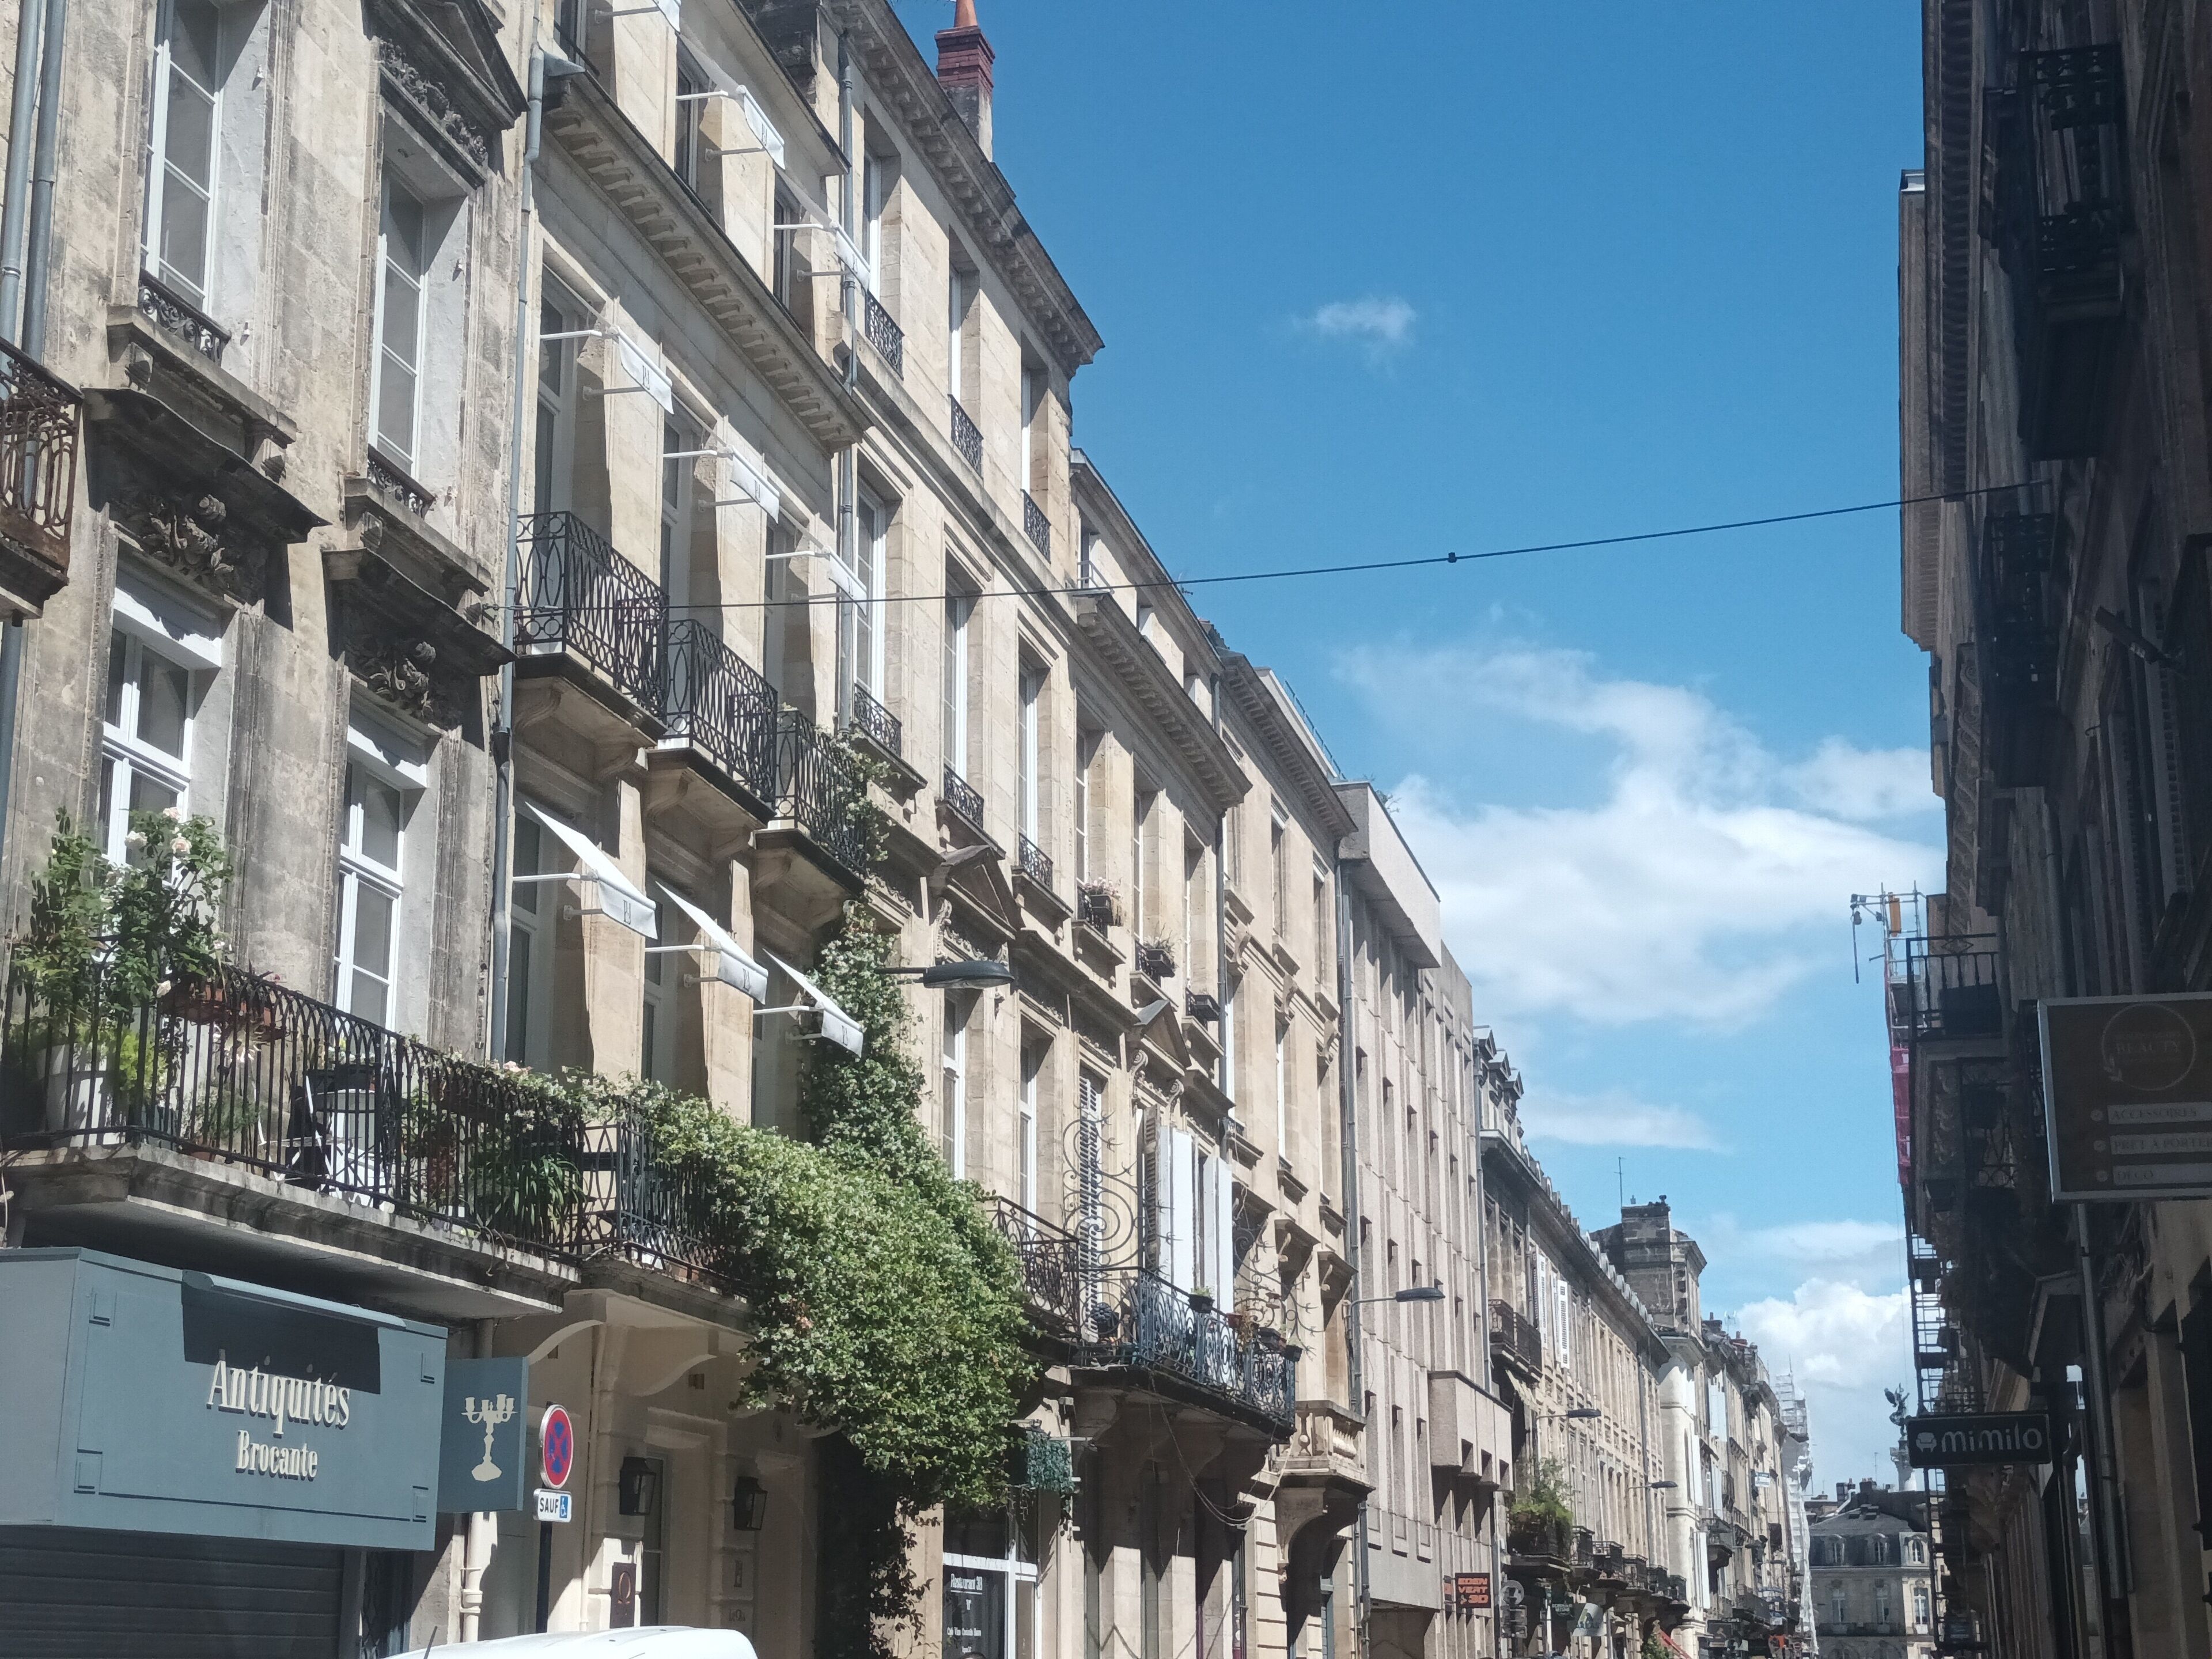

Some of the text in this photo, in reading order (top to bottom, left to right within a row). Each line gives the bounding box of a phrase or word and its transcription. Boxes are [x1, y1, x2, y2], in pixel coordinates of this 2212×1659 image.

[206, 1349, 350, 1434] Antiquités
[1941, 1421, 2042, 1452] mimilo
[235, 1430, 317, 1478] Brocante
[540, 1497, 559, 1514] SAUF
[950, 1573, 976, 1590] Restaurant
